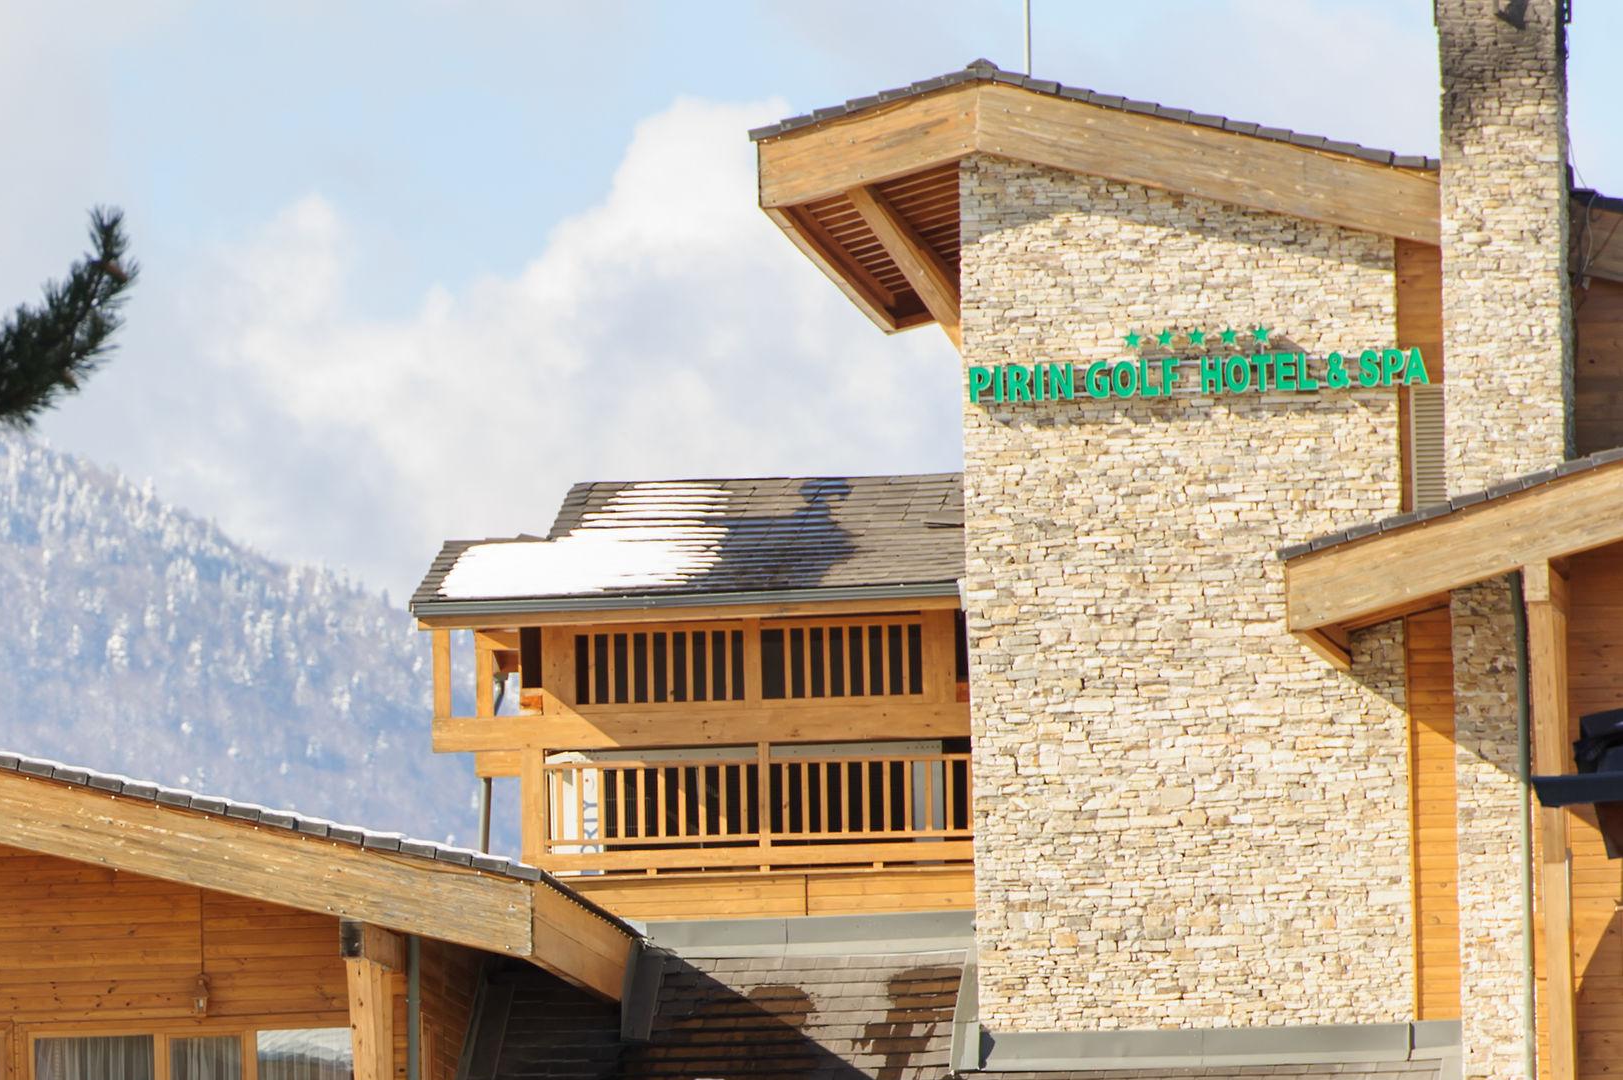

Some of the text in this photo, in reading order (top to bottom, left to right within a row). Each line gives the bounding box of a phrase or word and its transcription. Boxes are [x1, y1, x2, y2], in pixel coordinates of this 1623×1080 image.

[969, 346, 1430, 404] PIRIN GOLF HOTEL & SPA
